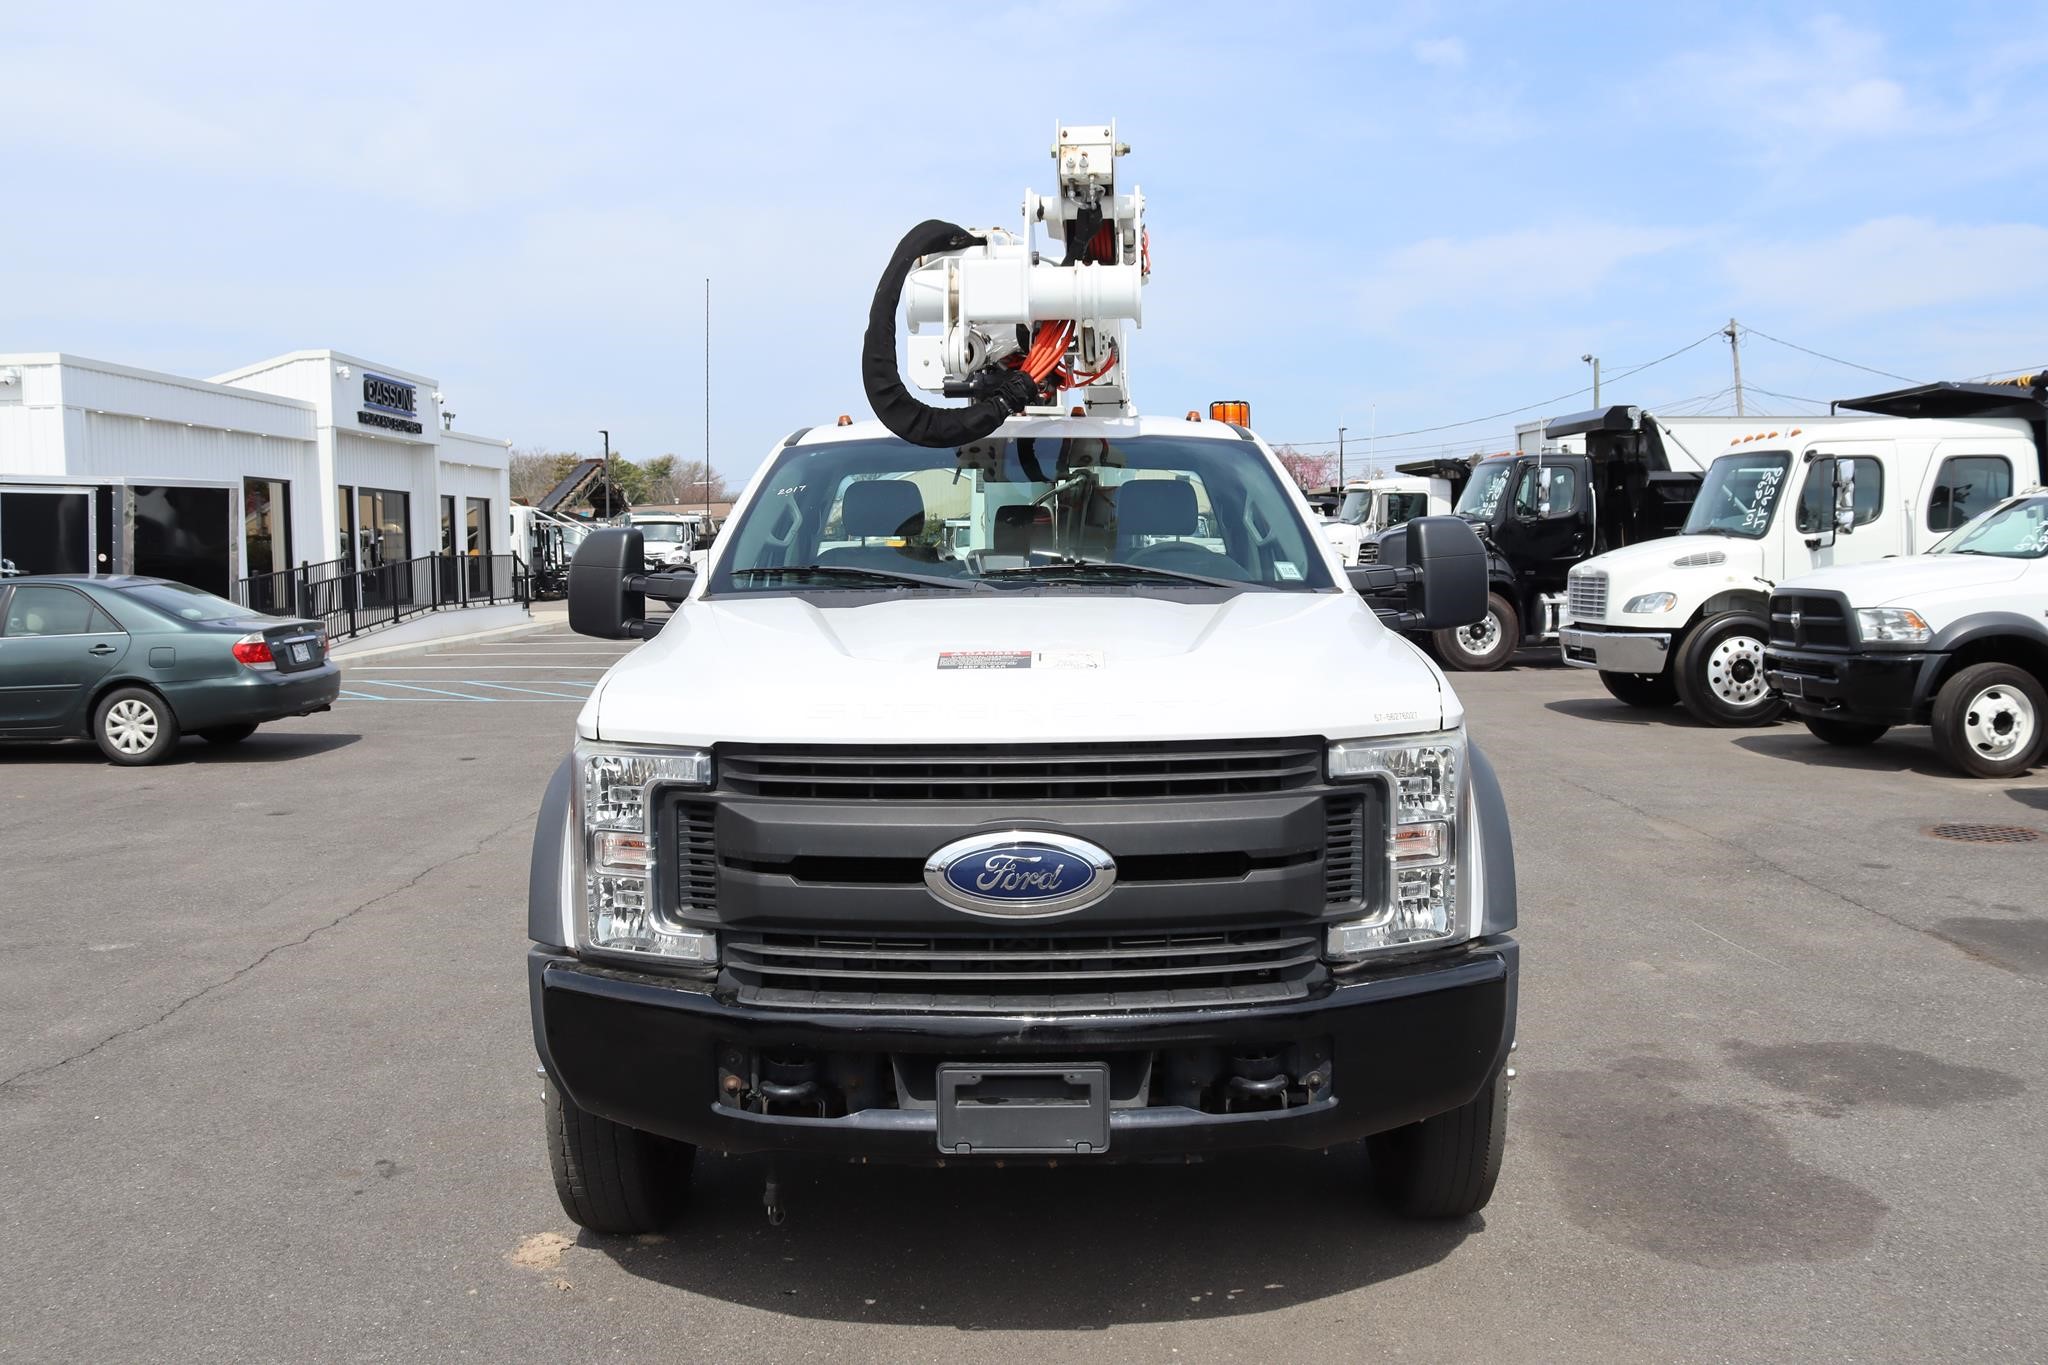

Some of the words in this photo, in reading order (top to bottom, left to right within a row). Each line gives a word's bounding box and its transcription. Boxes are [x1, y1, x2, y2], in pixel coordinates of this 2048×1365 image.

[364, 380, 417, 411] CASSONE
[777, 485, 806, 496] 2017
[976, 854, 1063, 891] Ford
